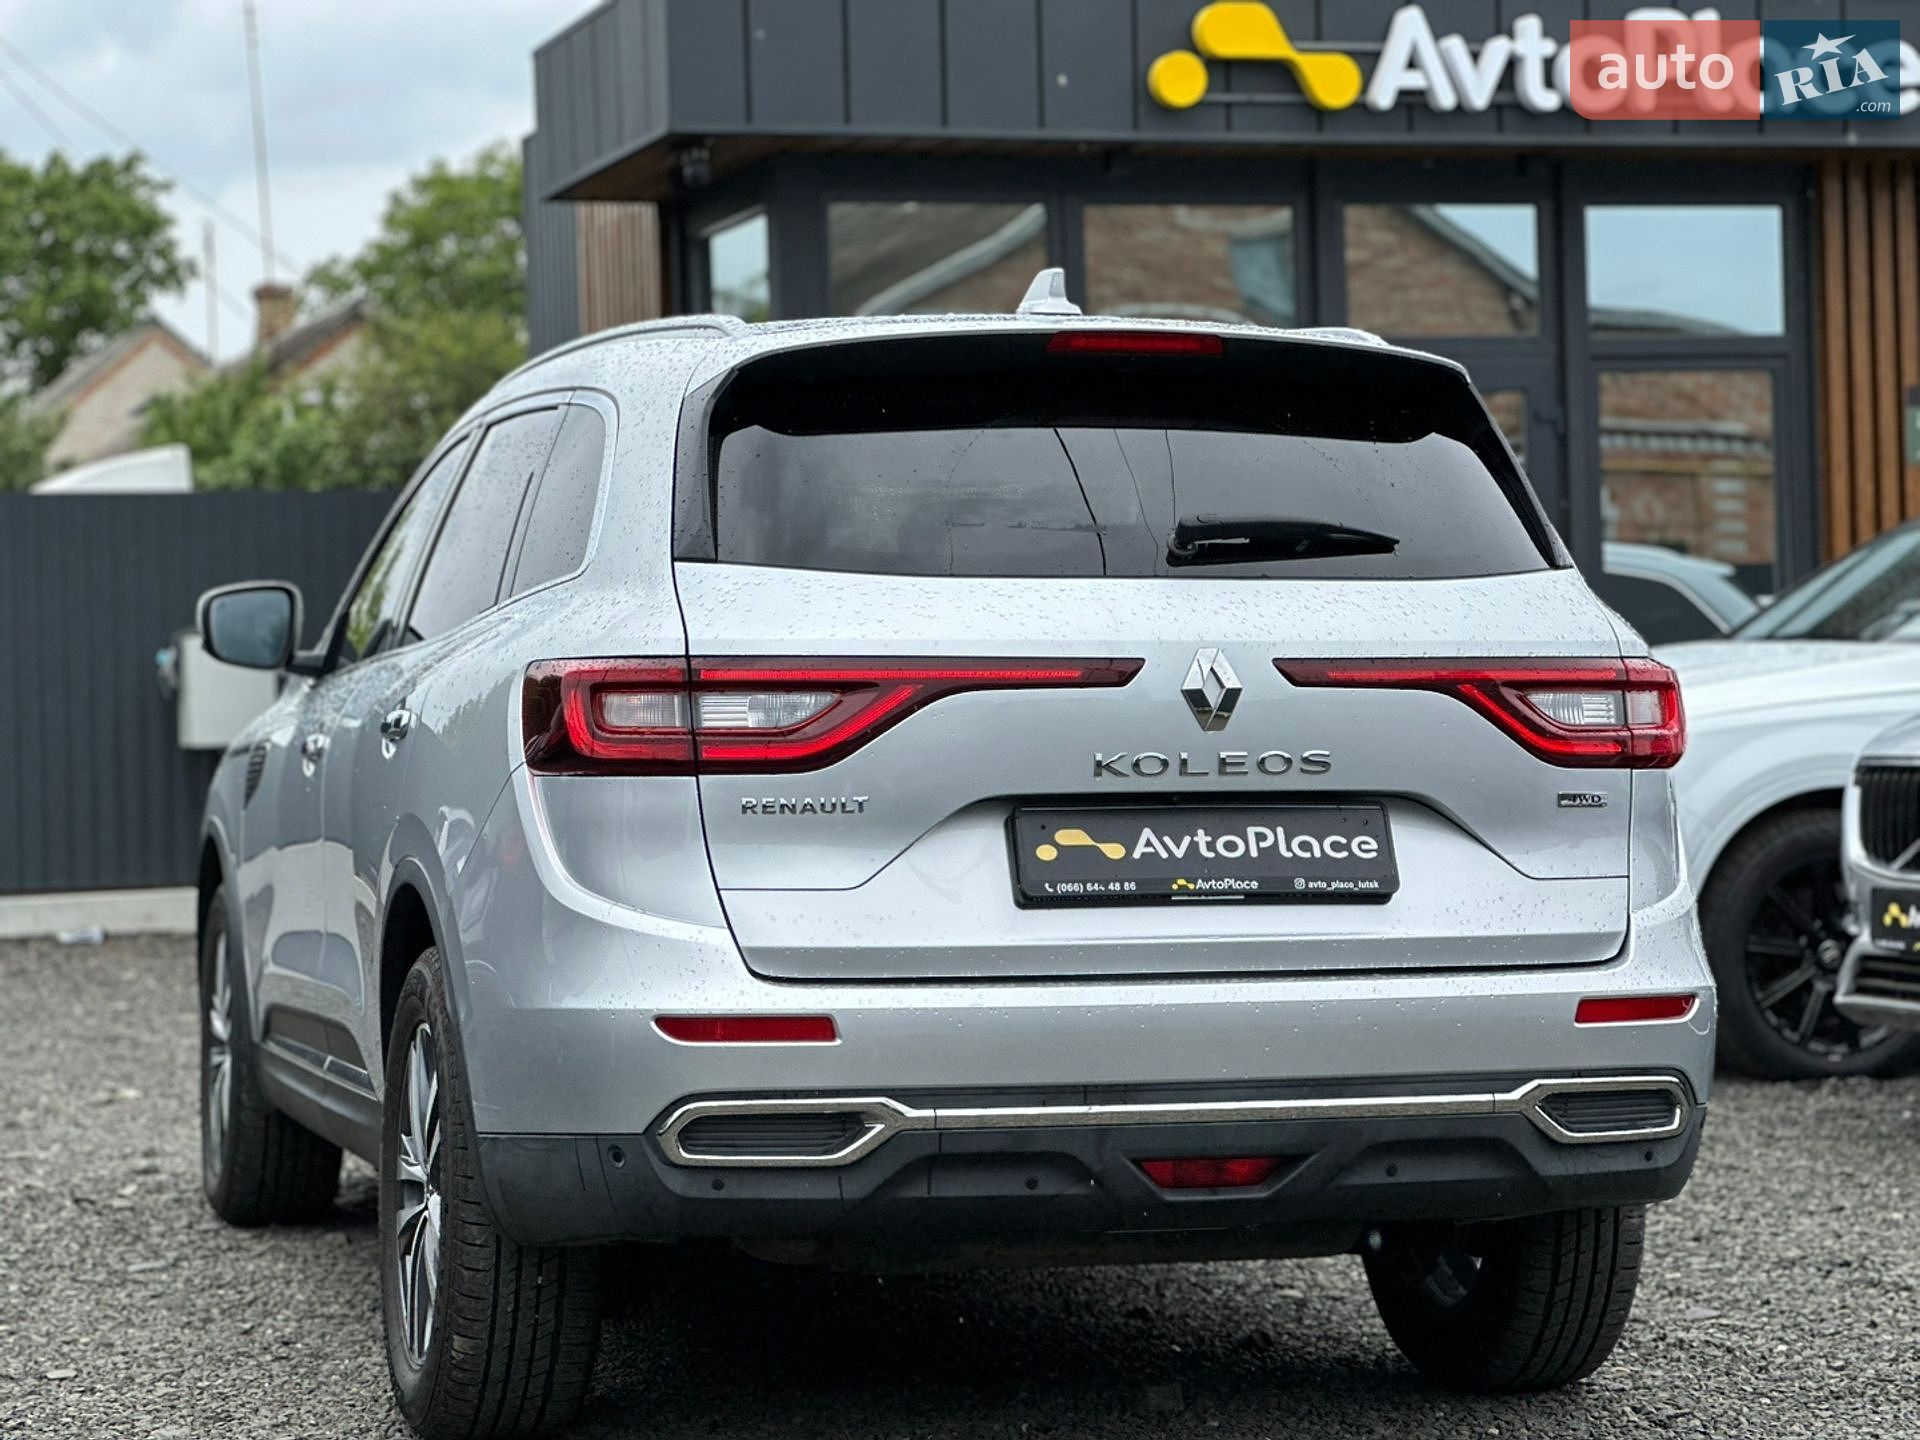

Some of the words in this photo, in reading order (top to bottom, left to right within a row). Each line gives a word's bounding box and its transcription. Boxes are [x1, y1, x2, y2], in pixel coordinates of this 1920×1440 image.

[1093, 750, 1333, 778] KOLEOS
[740, 795, 870, 816] RENAULT
[1132, 826, 1379, 860] AvtoPlace
[1056, 882, 1084, 894] (066)
[1108, 881, 1121, 891] 48
[1123, 881, 1136, 891] 86
[1195, 878, 1259, 889] AvtoPlace
